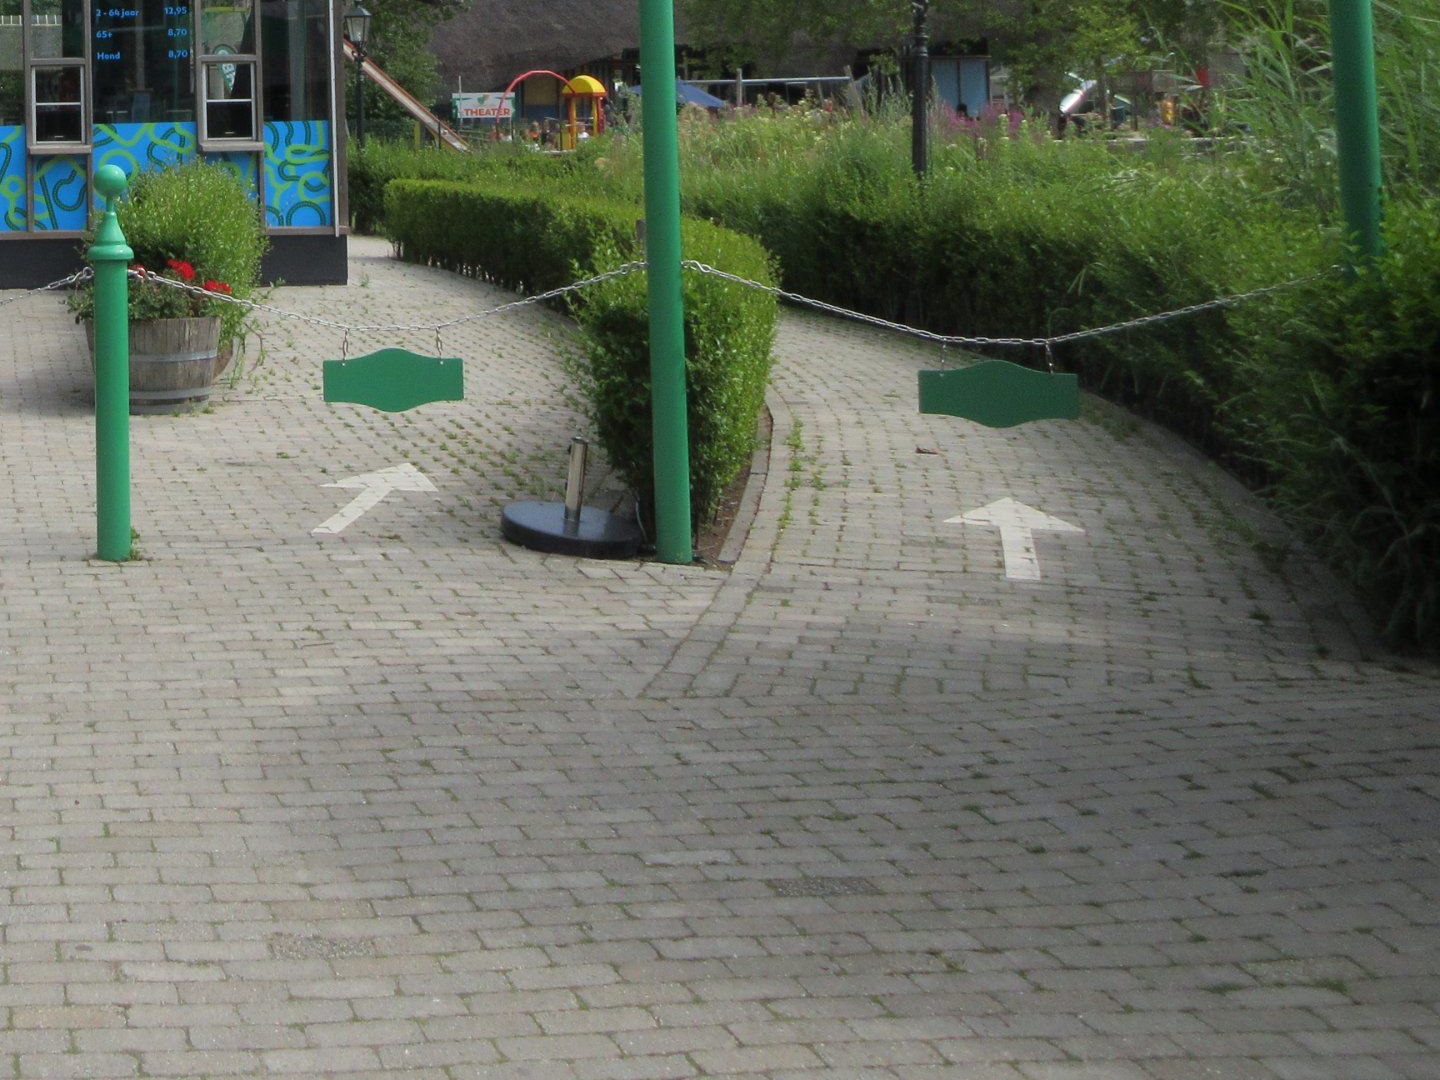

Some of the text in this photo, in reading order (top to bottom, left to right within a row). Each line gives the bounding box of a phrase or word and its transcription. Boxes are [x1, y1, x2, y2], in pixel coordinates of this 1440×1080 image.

[120, 8, 140, 18] jaar
[96, 52, 121, 60] Hond
[464, 108, 510, 116] THEATER
